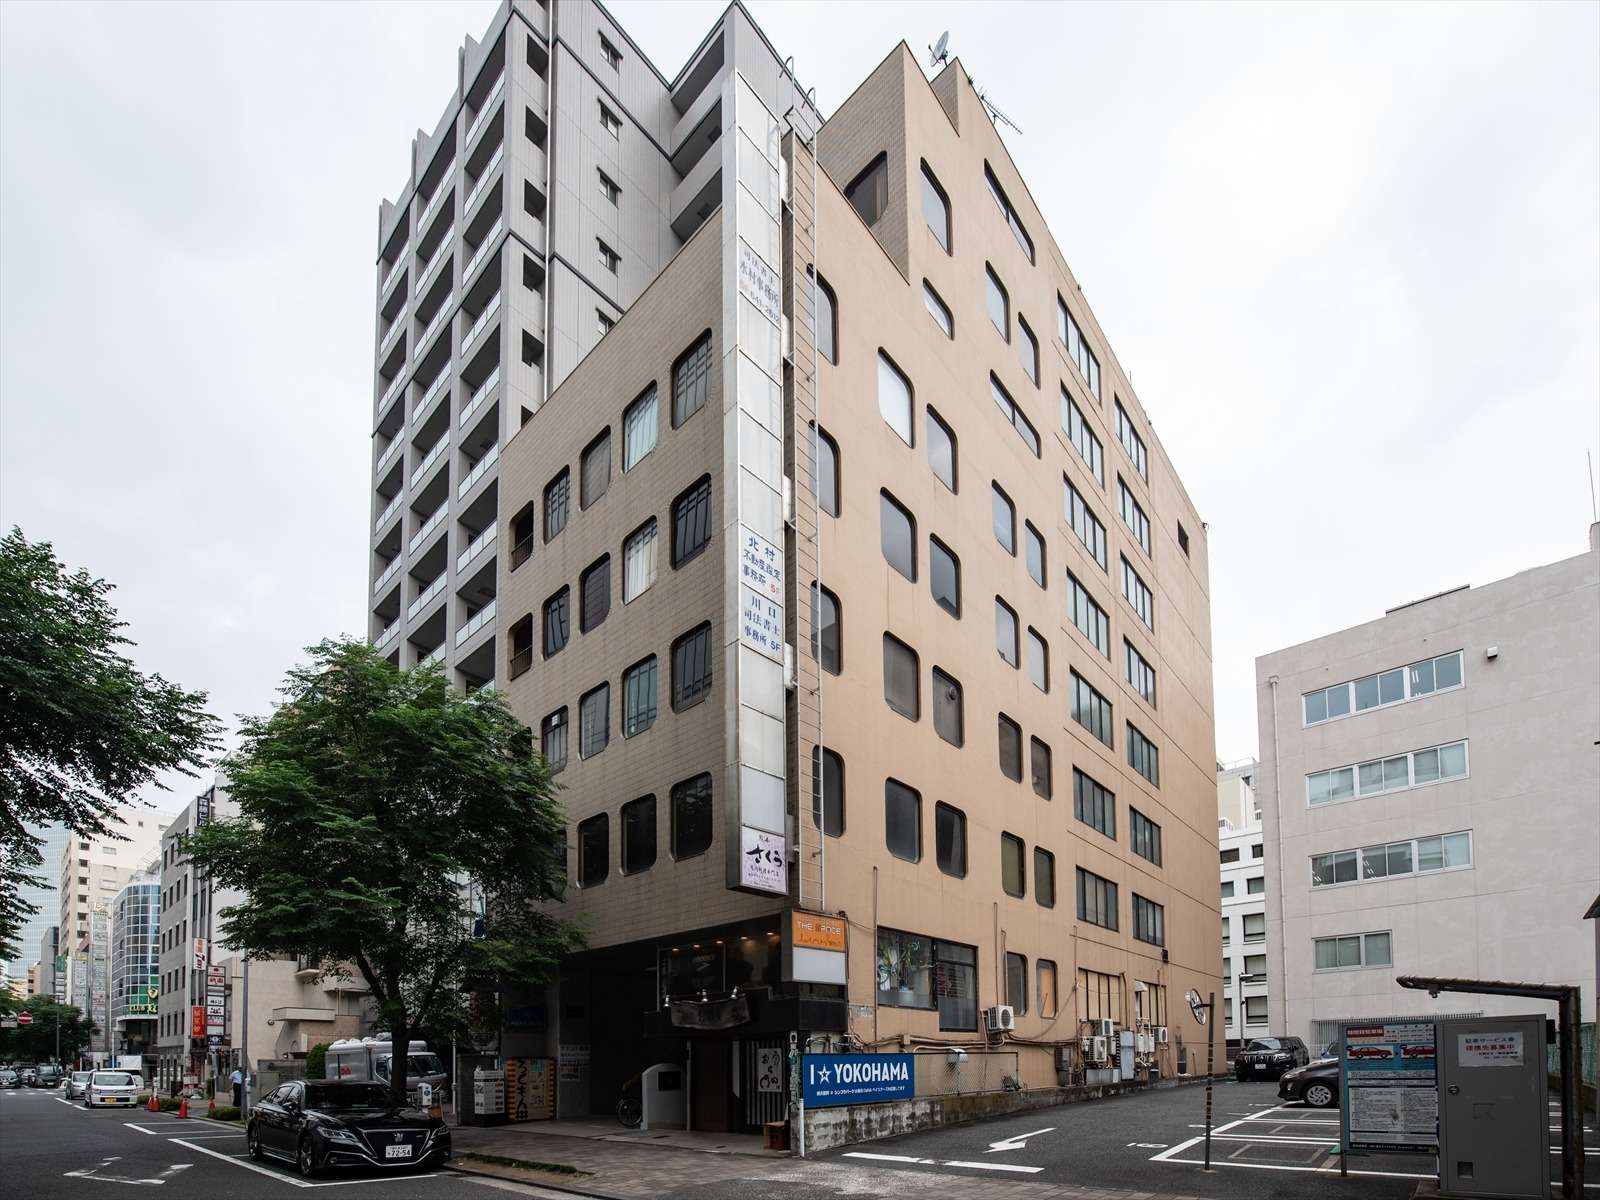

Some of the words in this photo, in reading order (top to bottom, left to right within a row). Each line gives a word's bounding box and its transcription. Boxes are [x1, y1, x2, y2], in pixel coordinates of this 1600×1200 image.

[748, 535, 776, 562] 北村
[751, 596, 776, 619] 川口
[744, 610, 780, 637] 司法書士
[744, 625, 767, 646] 事務所
[745, 843, 783, 868] さくら
[833, 1062, 909, 1084] YOKOHAMA
